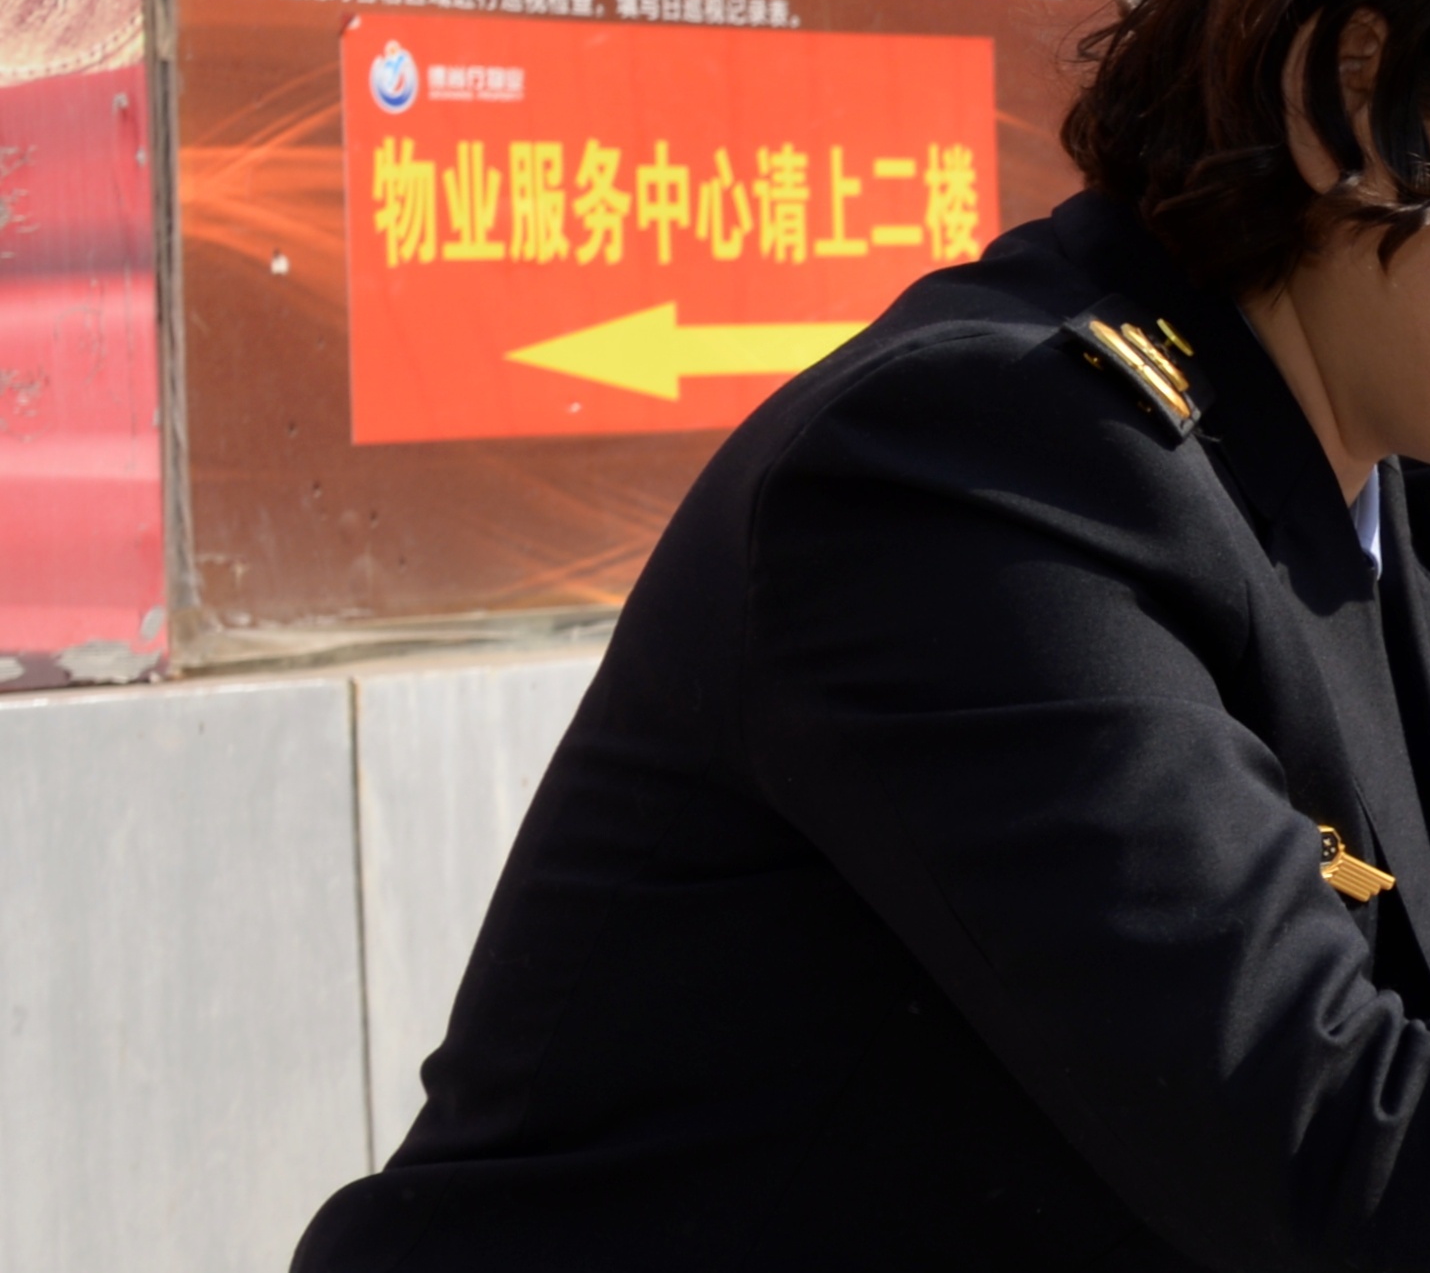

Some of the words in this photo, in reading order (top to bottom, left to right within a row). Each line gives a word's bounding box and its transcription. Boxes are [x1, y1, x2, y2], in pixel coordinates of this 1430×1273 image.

[372, 137, 980, 268] 物业服务中心请上二楼
